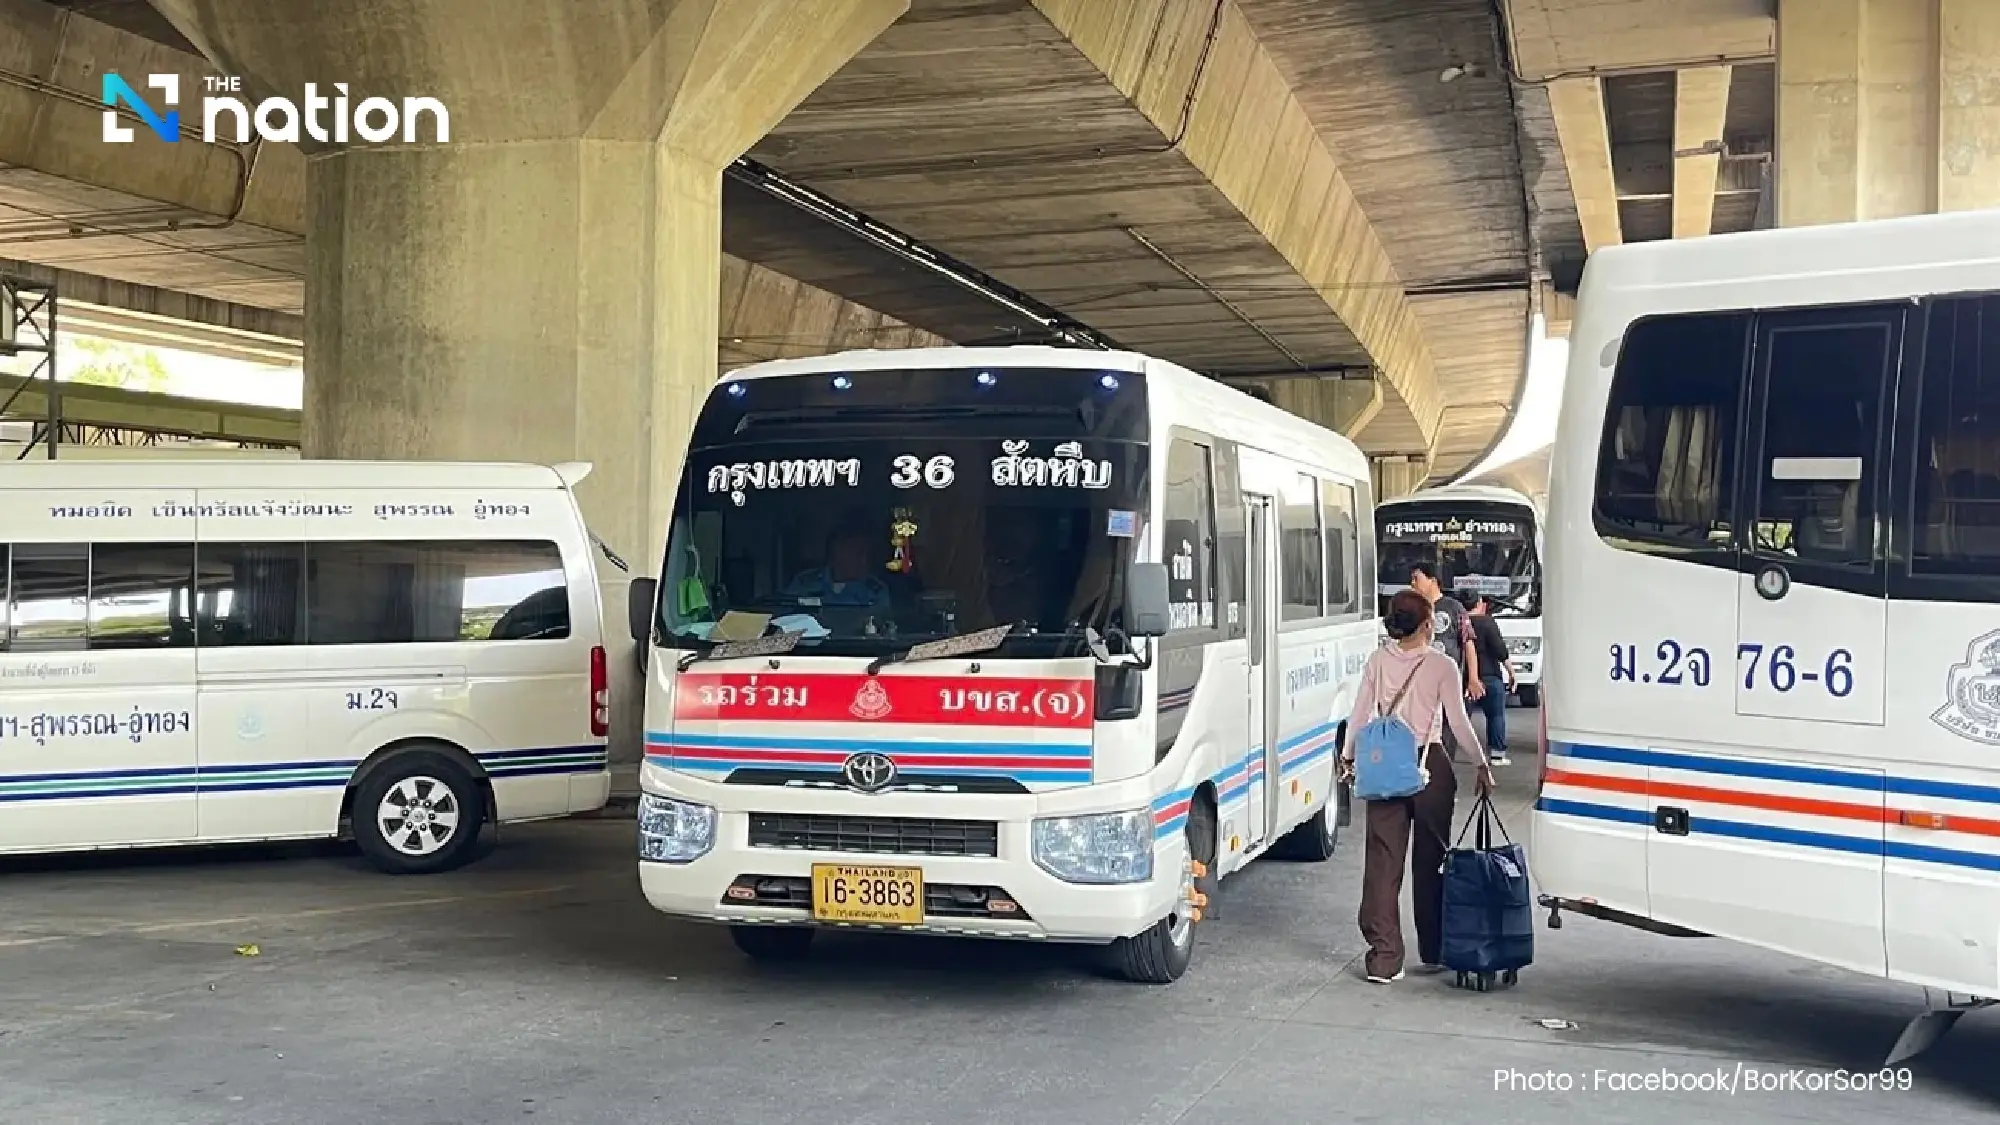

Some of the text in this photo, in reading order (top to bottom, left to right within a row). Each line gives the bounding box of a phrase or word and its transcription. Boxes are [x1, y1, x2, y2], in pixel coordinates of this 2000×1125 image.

[708, 440, 1112, 506] กรุงเทพฯ 36 สัตหีบ
[1610, 639, 1853, 698] ม.2จ 76-6
[346, 687, 398, 710] ม.2จ
[698, 675, 1086, 720] รถร่วม บขส.(จ)
[837, 867, 896, 878] THAILAND
[824, 877, 915, 907] 16-3863
